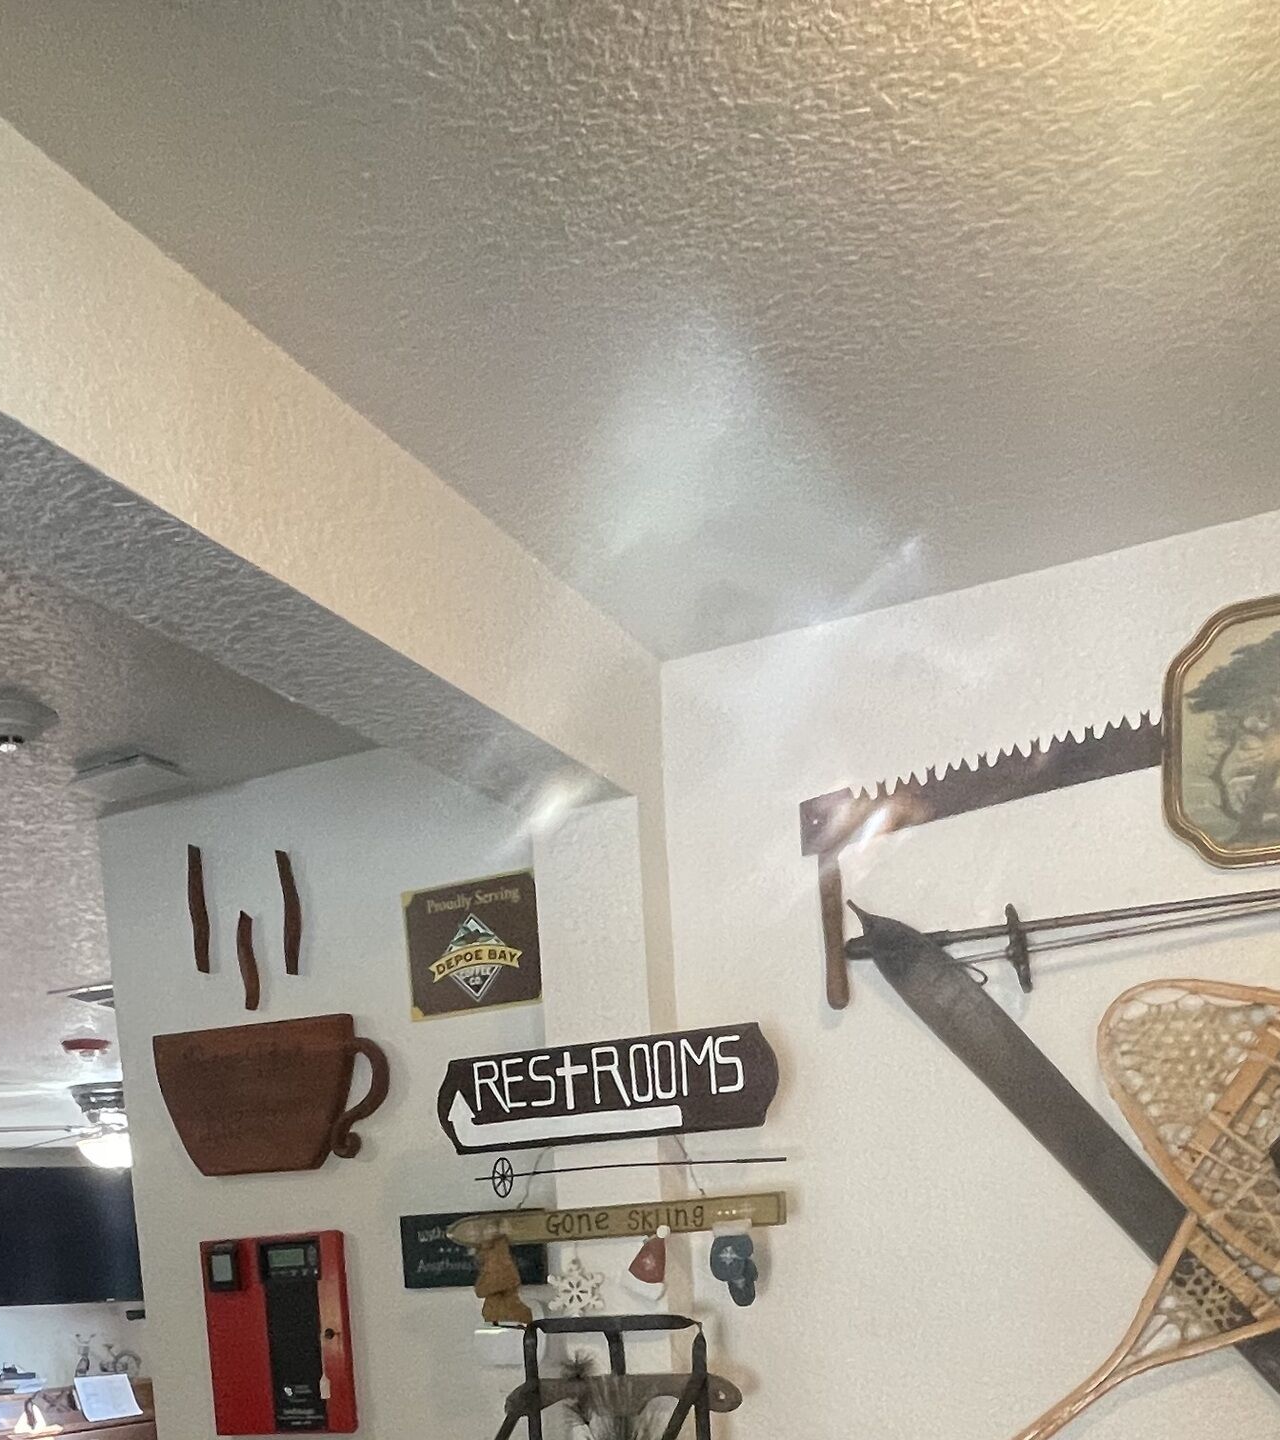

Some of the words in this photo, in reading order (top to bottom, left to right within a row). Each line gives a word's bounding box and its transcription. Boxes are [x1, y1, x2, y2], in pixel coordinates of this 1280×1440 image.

[426, 893, 472, 914] Proudly
[474, 887, 520, 904] Serving
[436, 949, 483, 975] DEPOE
[488, 949, 517, 962] BAY
